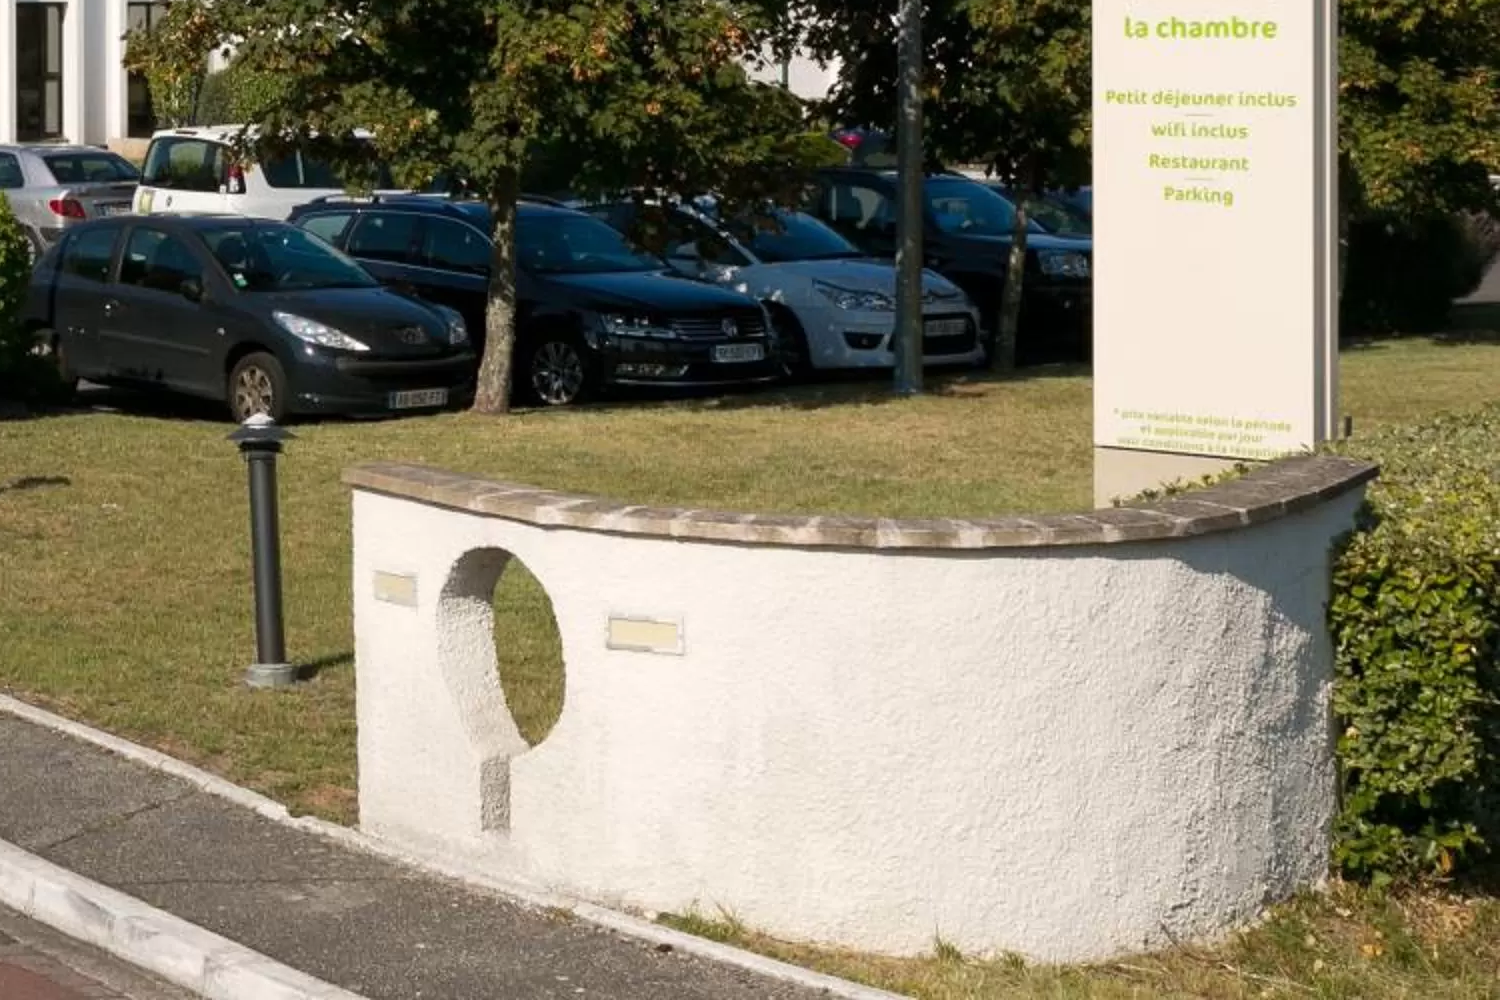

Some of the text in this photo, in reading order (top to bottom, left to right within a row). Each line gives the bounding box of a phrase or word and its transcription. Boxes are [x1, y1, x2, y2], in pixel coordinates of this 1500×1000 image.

[1123, 16, 1278, 39] la chambre
[1104, 89, 1298, 109] Petit déjeuner inclus
[1151, 122, 1249, 140] wifi inclus
[1148, 154, 1251, 172] Restaurant
[1163, 187, 1235, 207] Parking
